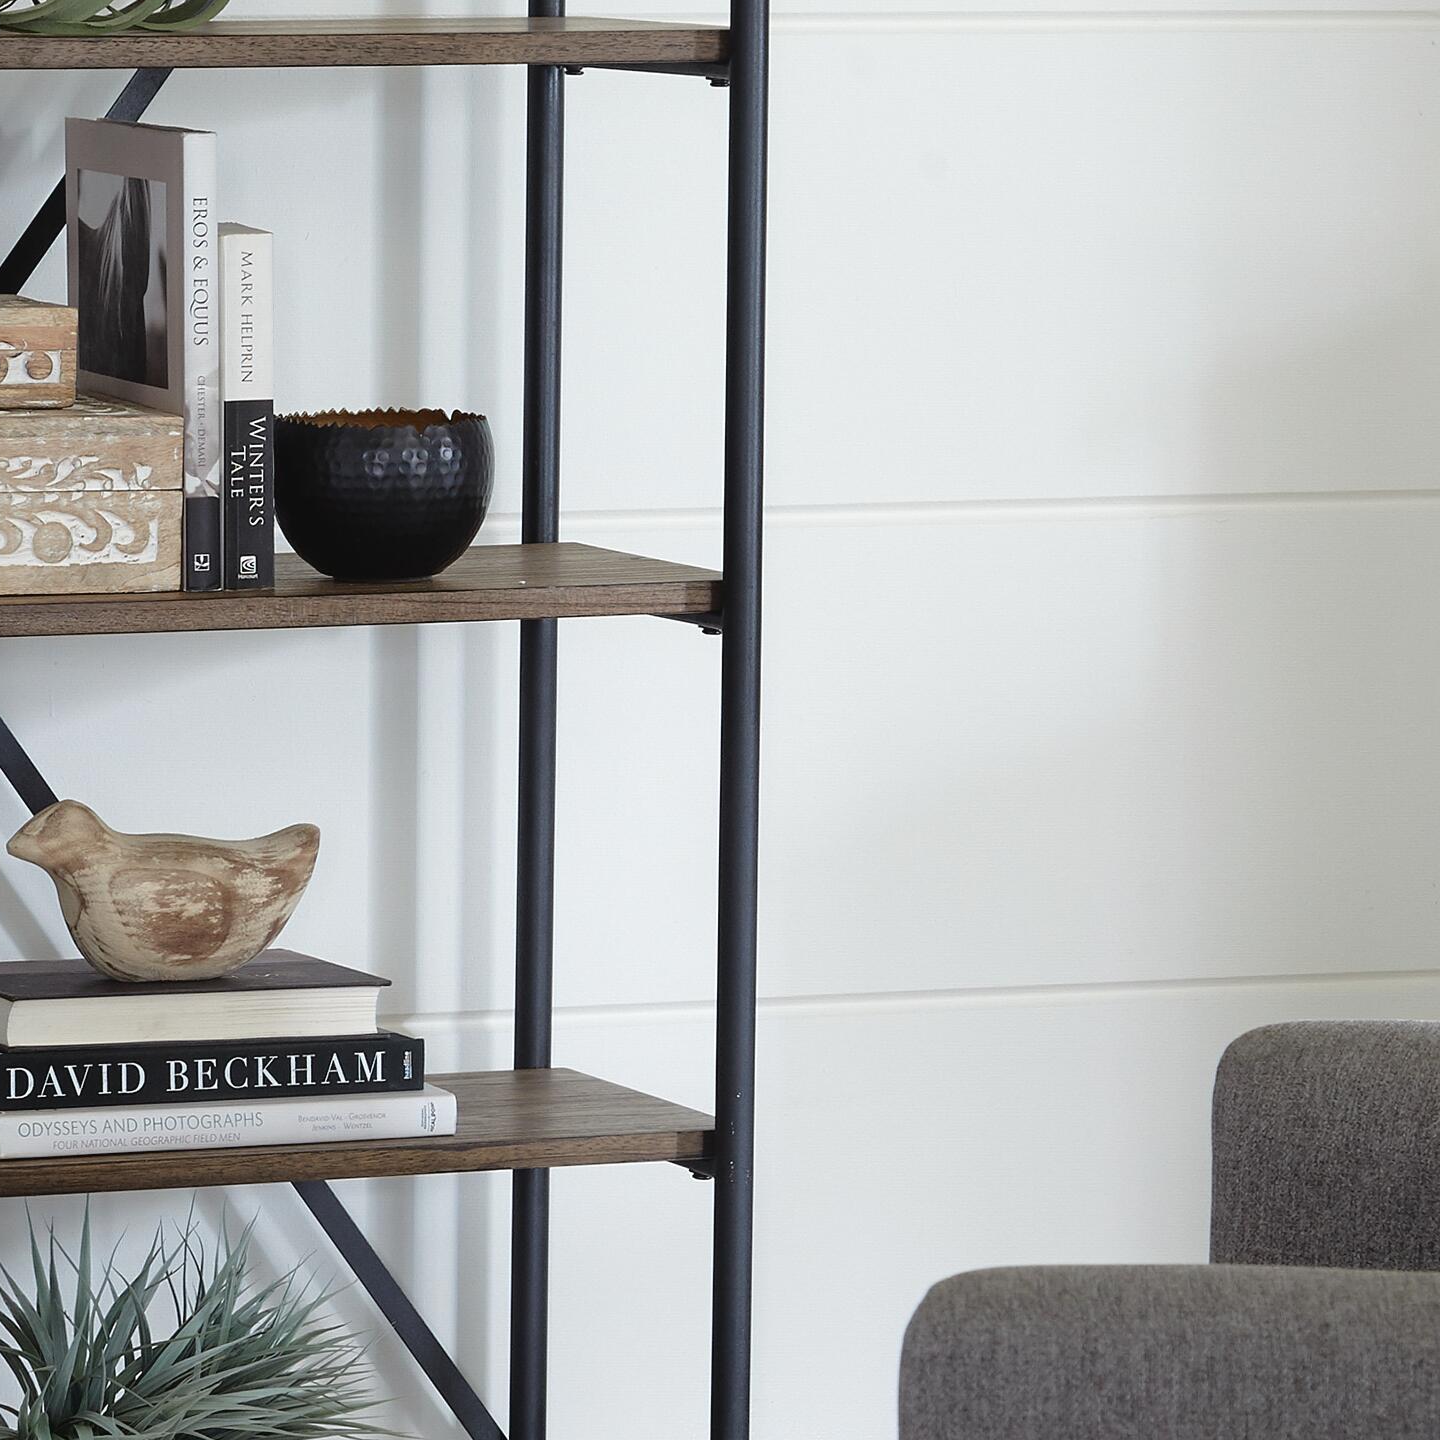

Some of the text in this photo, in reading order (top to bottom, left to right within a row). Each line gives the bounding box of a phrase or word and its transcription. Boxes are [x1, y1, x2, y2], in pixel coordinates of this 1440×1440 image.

[190, 198, 209, 346] EROS & EQUUS
[240, 251, 254, 382] MARK HELPRIN
[197, 375, 206, 420] CHESTER
[230, 445, 247, 498] TALE
[248, 416, 267, 527] WINTER'S
[5, 1061, 146, 1100] DAVID
[165, 1050, 387, 1093] BECKHAM
[17, 1111, 264, 1138] ODYSSEYS AND PHOTOGRAPHS
[52, 1132, 242, 1150] FOUR NATIONAL GEOGRAPHIC FIELD MEN
